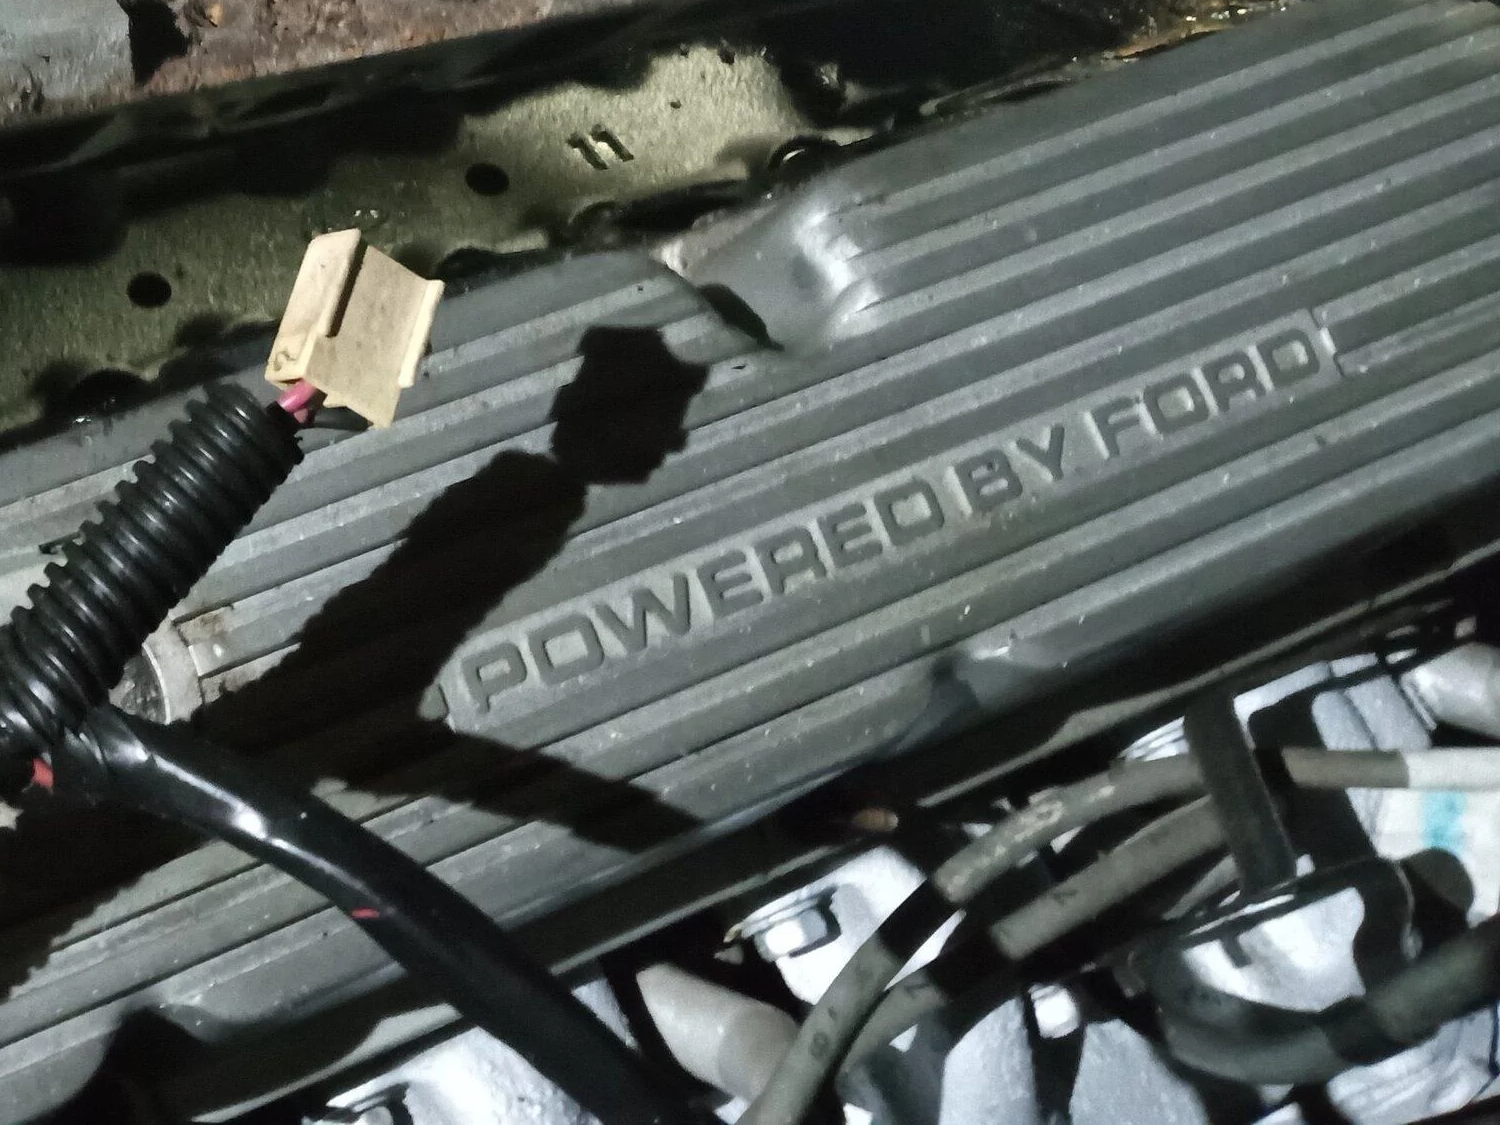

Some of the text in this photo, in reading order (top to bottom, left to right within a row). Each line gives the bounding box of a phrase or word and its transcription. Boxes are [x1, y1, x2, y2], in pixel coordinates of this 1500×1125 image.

[461, 326, 1323, 713] POWERED BY FORD
